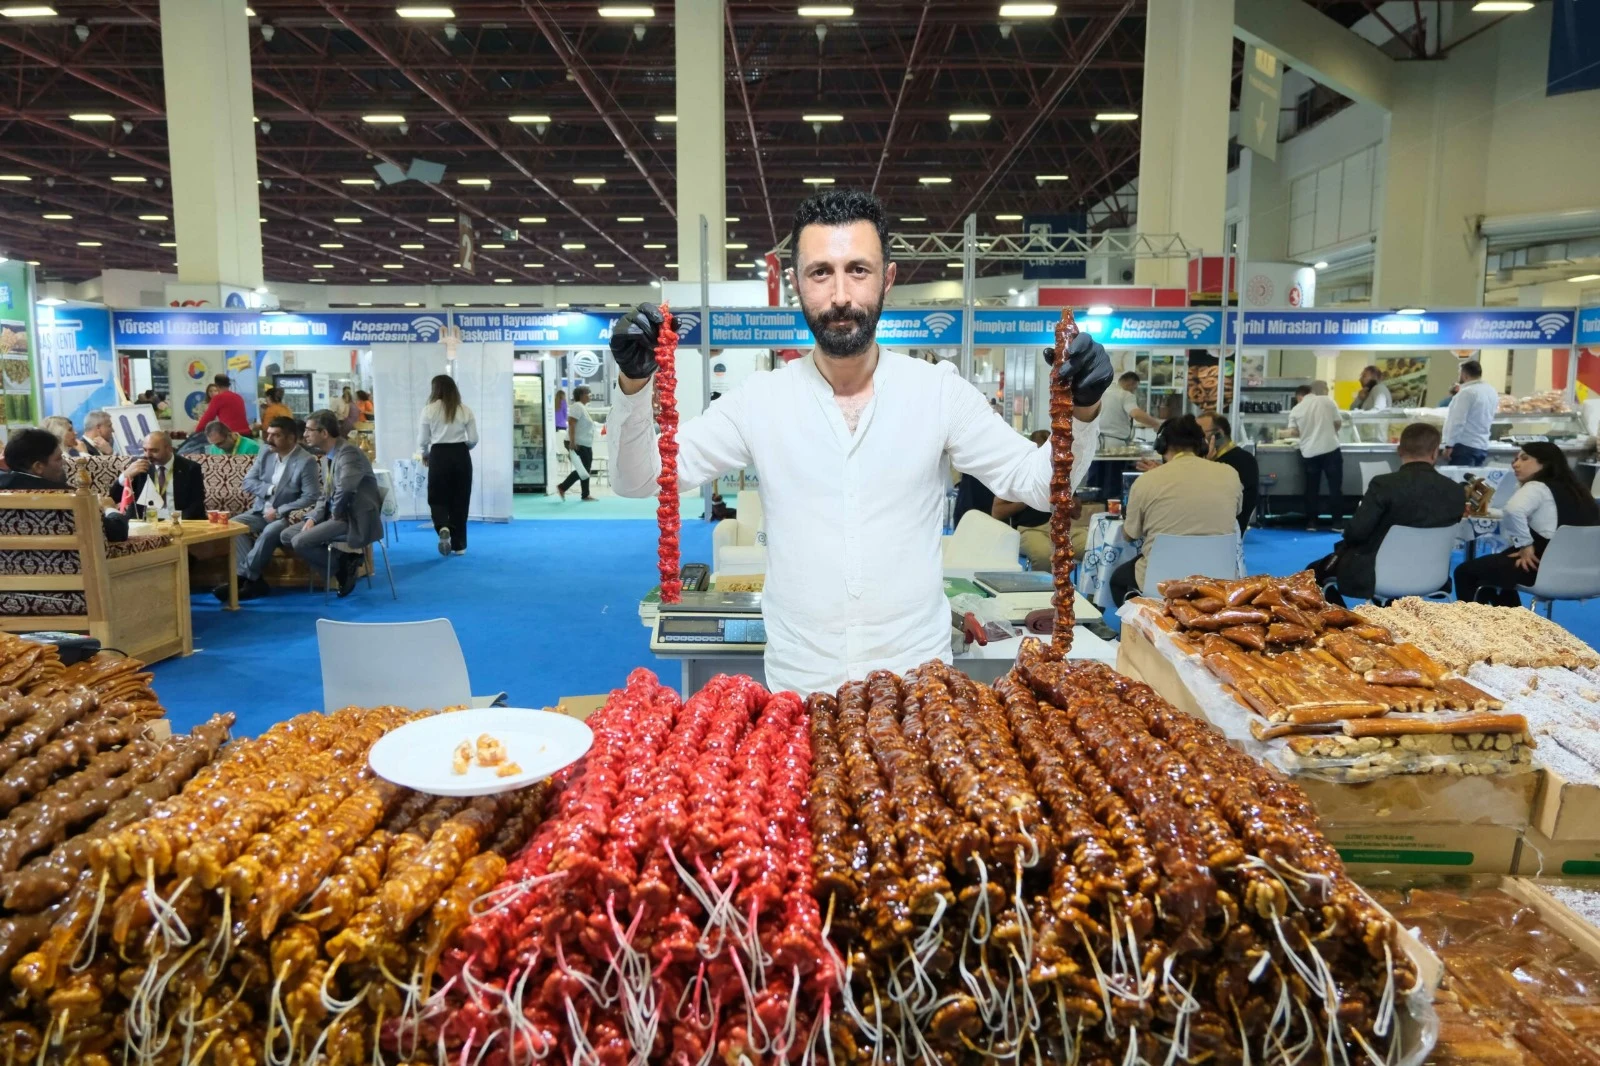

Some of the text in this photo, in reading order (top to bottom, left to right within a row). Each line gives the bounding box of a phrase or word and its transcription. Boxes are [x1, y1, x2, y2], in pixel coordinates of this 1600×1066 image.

[462, 234, 472, 271] 2
[459, 315, 486, 327] Tarım
[488, 317, 501, 326] ve
[712, 313, 795, 326] Sağlık Turizminin
[877, 318, 920, 330] psama
[1121, 317, 1180, 330] Kapsama
[1267, 319, 1322, 334] Mirasları
[1324, 319, 1340, 334] ile
[1341, 318, 1369, 334] ünlü
[1371, 319, 1439, 334] Erz'un
[1474, 319, 1533, 331] Kapsama
[118, 318, 328, 337] Yöresel Lezzetler Diyarı Erm'un
[352, 320, 411, 333] Kapsama
[875, 328, 929, 338] ındasınız
[1018, 320, 1044, 333] Kenti
[503, 328, 559, 341] Erzurum'un
[712, 328, 809, 340] Merkezi Erzurum'un
[59, 349, 99, 377] BEKLERİZ
